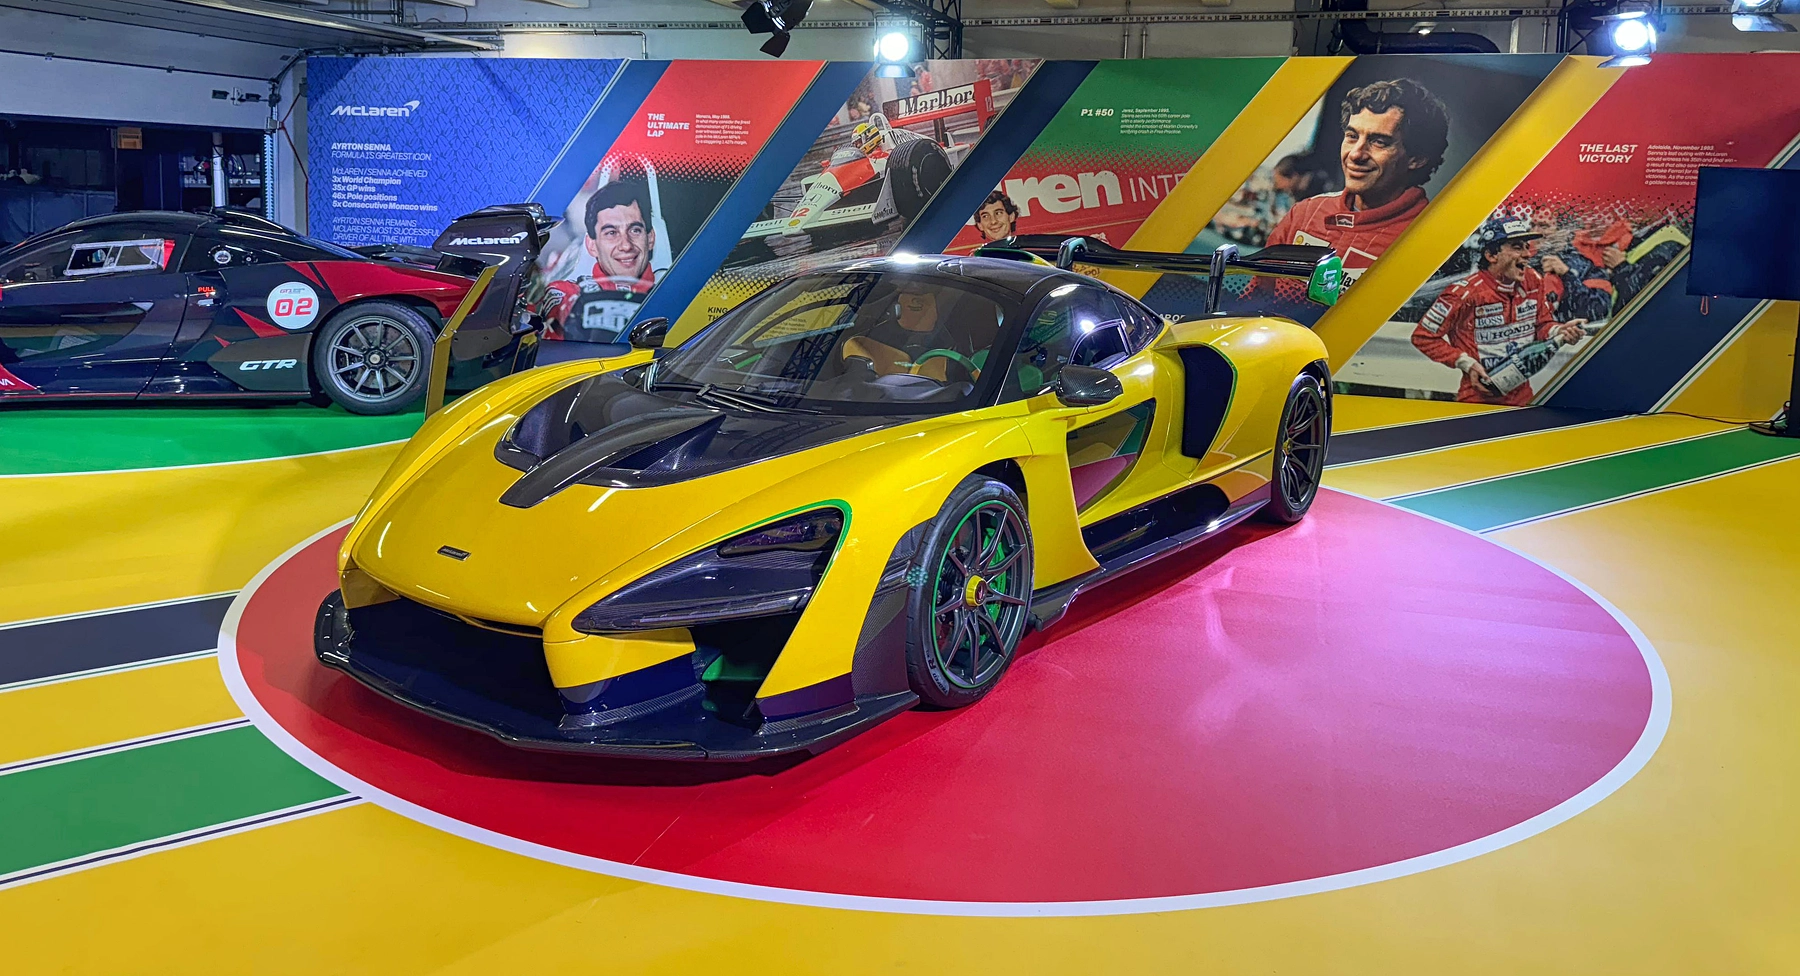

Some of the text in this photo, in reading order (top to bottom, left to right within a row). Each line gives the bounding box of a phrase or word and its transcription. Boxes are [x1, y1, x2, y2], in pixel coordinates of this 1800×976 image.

[903, 88, 976, 116] Marlbor
[330, 104, 410, 117] McLaren
[1095, 108, 1114, 116] #50
[331, 142, 363, 150] AYRTON
[1579, 144, 1638, 153] THE LAST
[331, 151, 364, 159] FORMULA
[1578, 154, 1633, 164] VICTORY
[392, 169, 428, 177] ACHIEVED
[364, 177, 401, 185] Champion
[363, 193, 397, 202] positions
[1003, 170, 1124, 217] ren
[342, 201, 388, 209] Consecutive
[830, 204, 874, 216] Shell
[393, 228, 440, 236] SUCCESSFUL
[448, 236, 520, 245] McLaren
[274, 297, 313, 316] 02
[1478, 316, 1502, 326] BOSS
[239, 359, 297, 370] GTR
